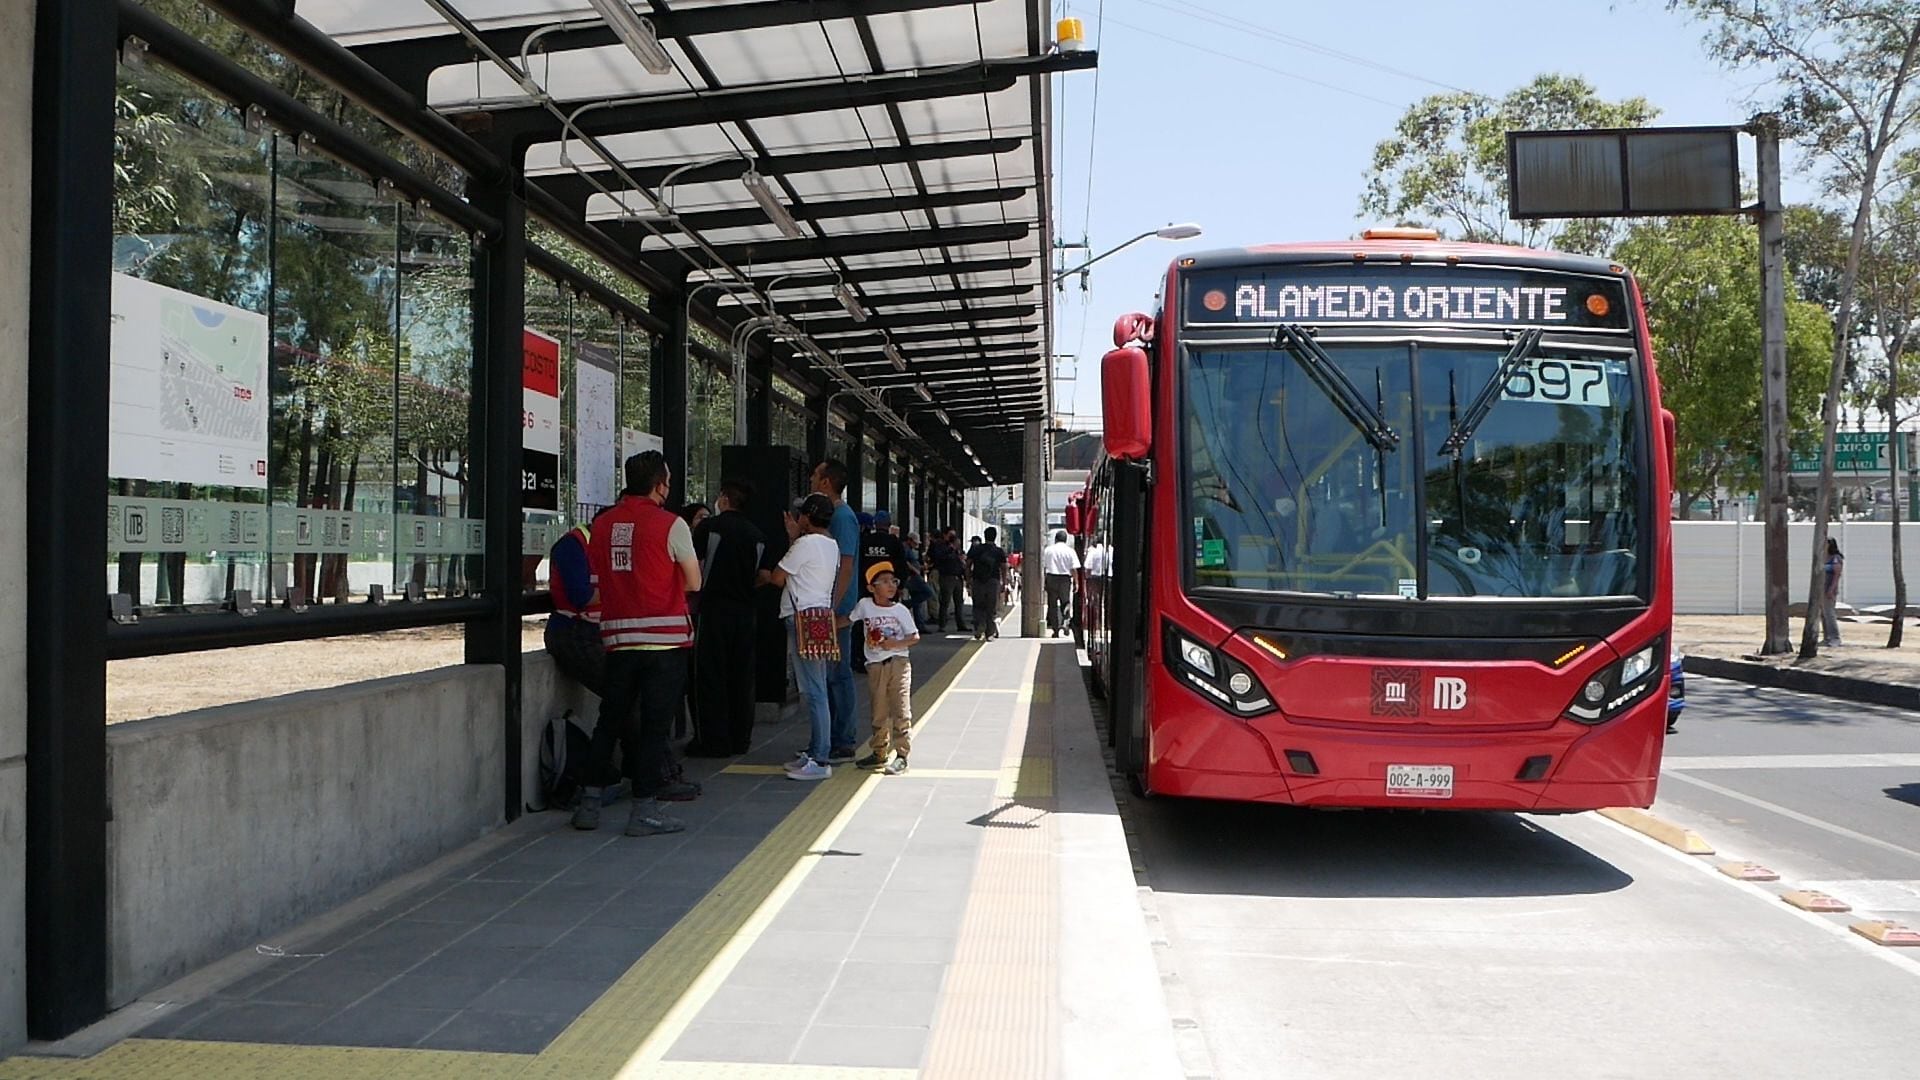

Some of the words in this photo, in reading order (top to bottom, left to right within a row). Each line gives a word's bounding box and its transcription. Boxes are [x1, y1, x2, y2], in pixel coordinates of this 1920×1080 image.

[1235, 285, 1395, 318] ALAMEDA
[1403, 286, 1568, 320] ORIENTE
[1834, 443, 1872, 453] EXICO
[1389, 773, 1451, 788] 002-A-999
